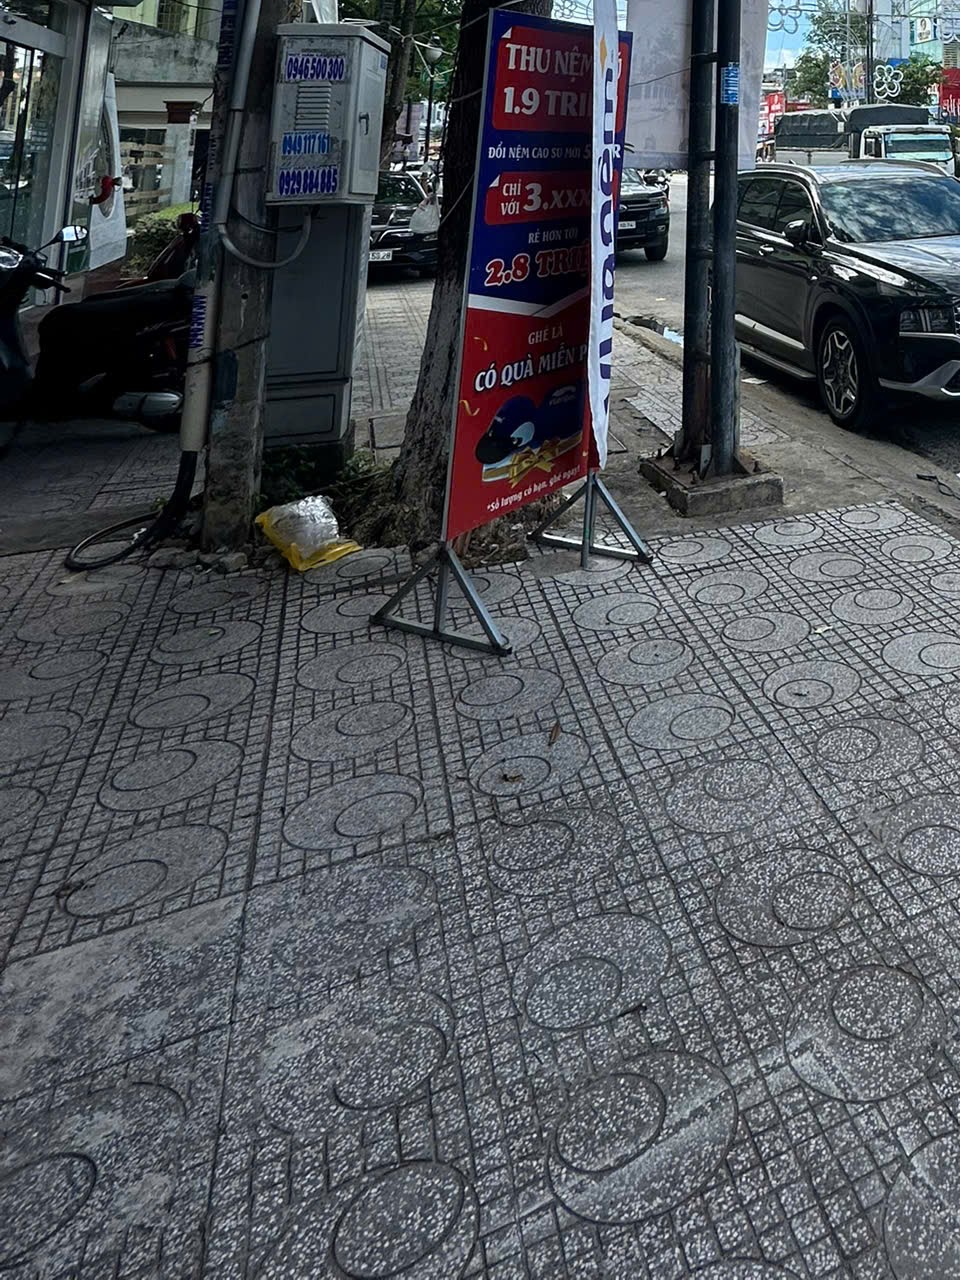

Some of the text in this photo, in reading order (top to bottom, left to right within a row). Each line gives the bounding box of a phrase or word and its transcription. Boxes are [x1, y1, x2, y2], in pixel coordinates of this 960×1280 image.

[505, 43, 550, 74] THU
[554, 46, 593, 83] NỆM
[504, 86, 593, 118] 1.9 TRI
[488, 141, 506, 159] ĐỔI
[508, 144, 530, 161] NỆM
[531, 147, 549, 159] CAO
[502, 179, 521, 196] CHỈ
[501, 198, 520, 216] VỚI
[528, 227, 540, 244] RẺ
[484, 252, 530, 287] 2.8
[475, 363, 497, 393] CÓ
[501, 353, 534, 387] QUÀ
[538, 341, 576, 375] MIỄN
[523, 485, 533, 497] có
